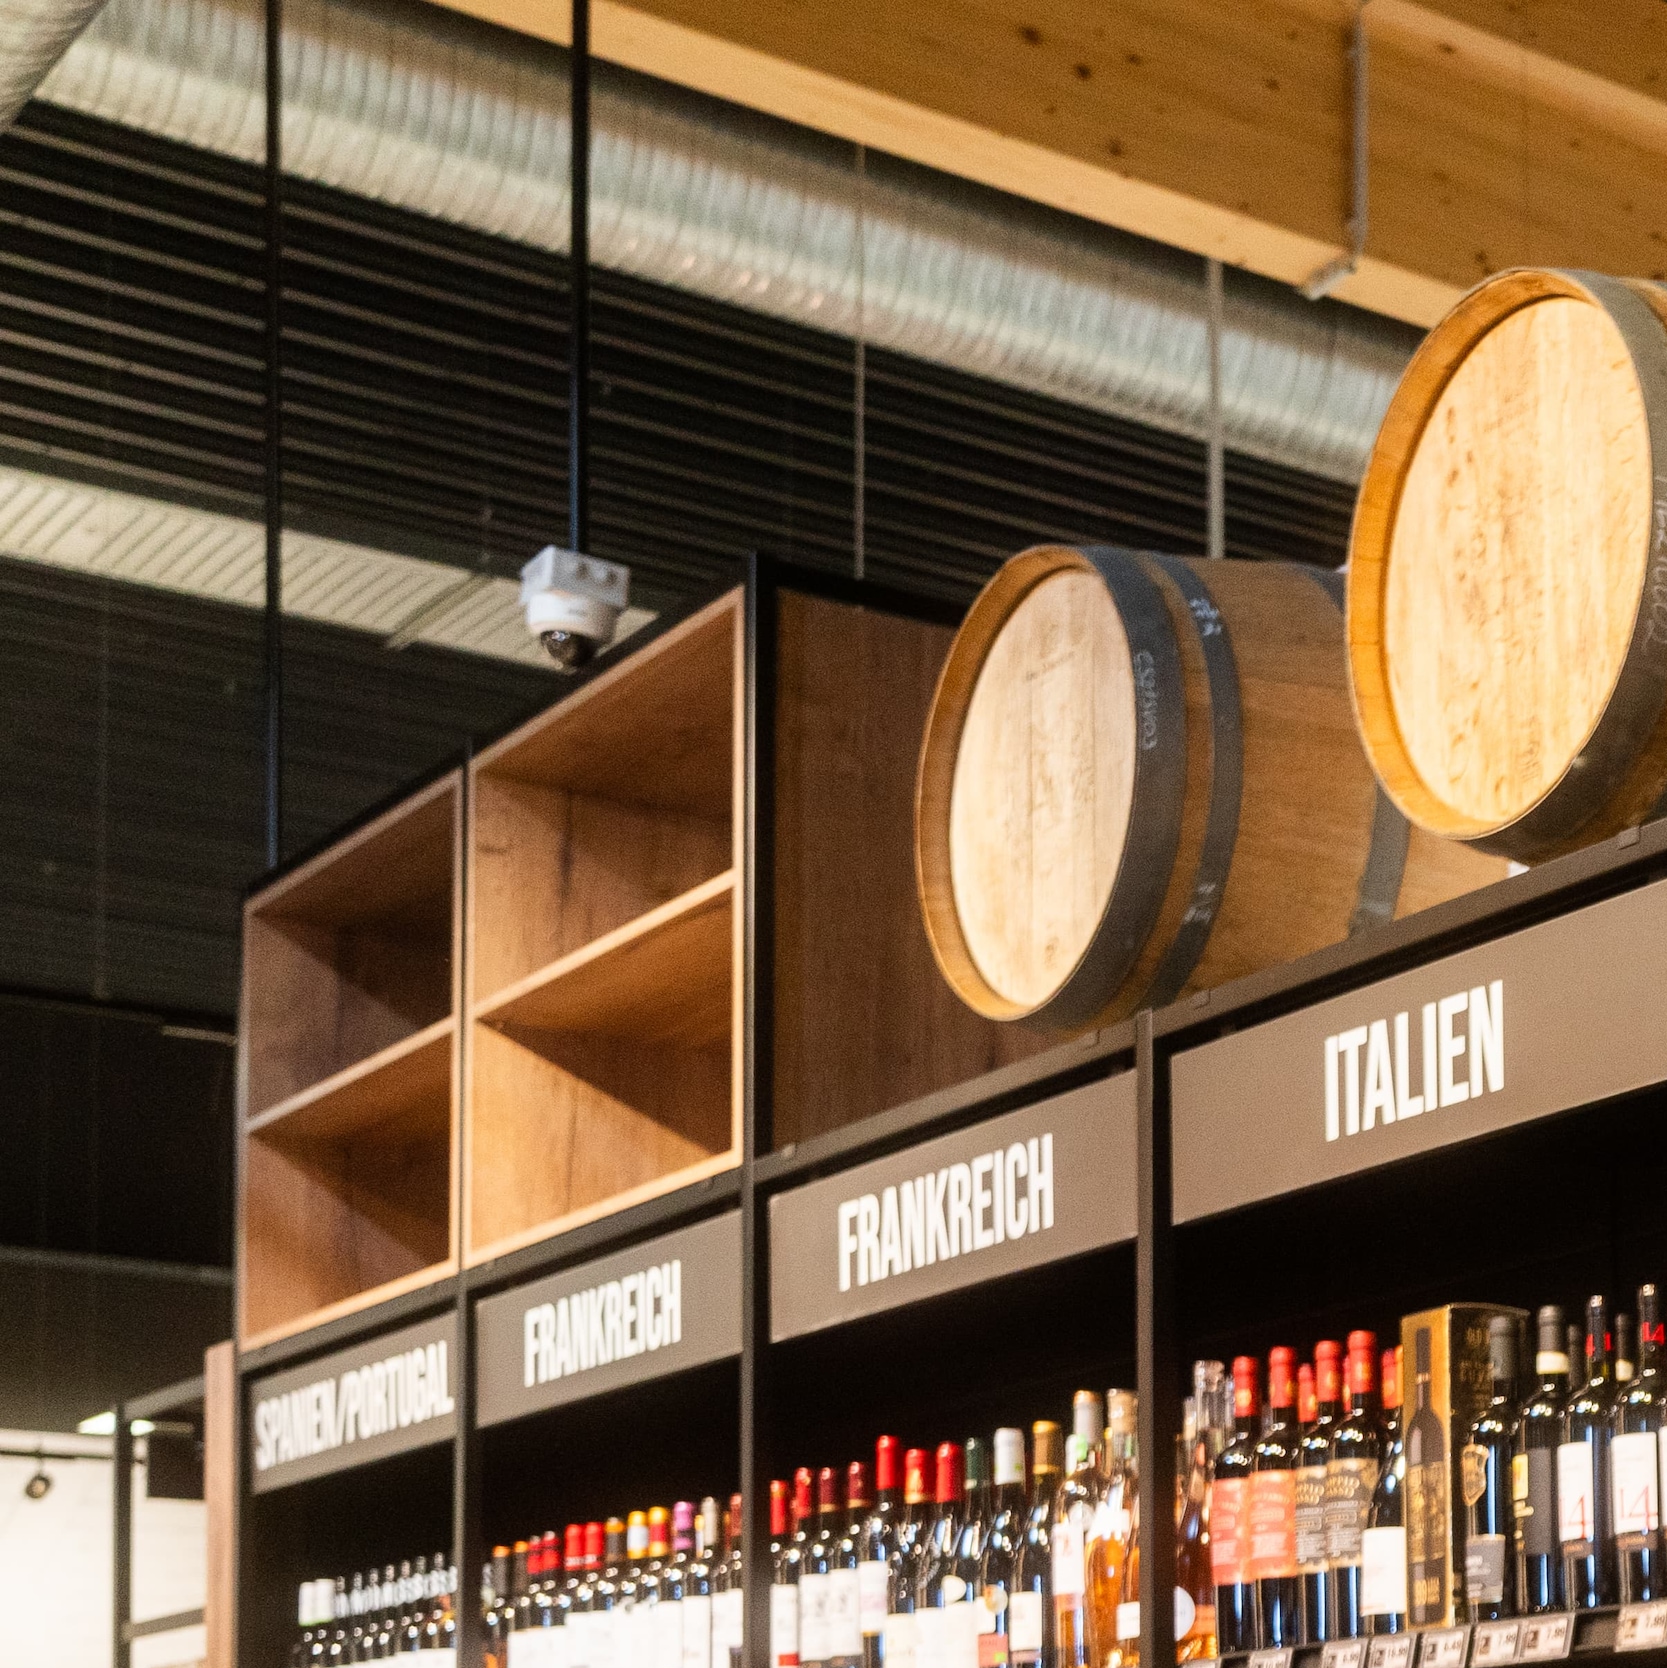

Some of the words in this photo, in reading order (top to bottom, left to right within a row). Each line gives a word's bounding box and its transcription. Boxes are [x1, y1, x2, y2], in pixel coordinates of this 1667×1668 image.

[1323, 978, 1506, 1142] ITALIEN
[838, 1133, 1054, 1292] FRANKREICH
[523, 1259, 682, 1388] FRANKREICH
[255, 1341, 455, 1470] SPANIEN/PORTUGAL
